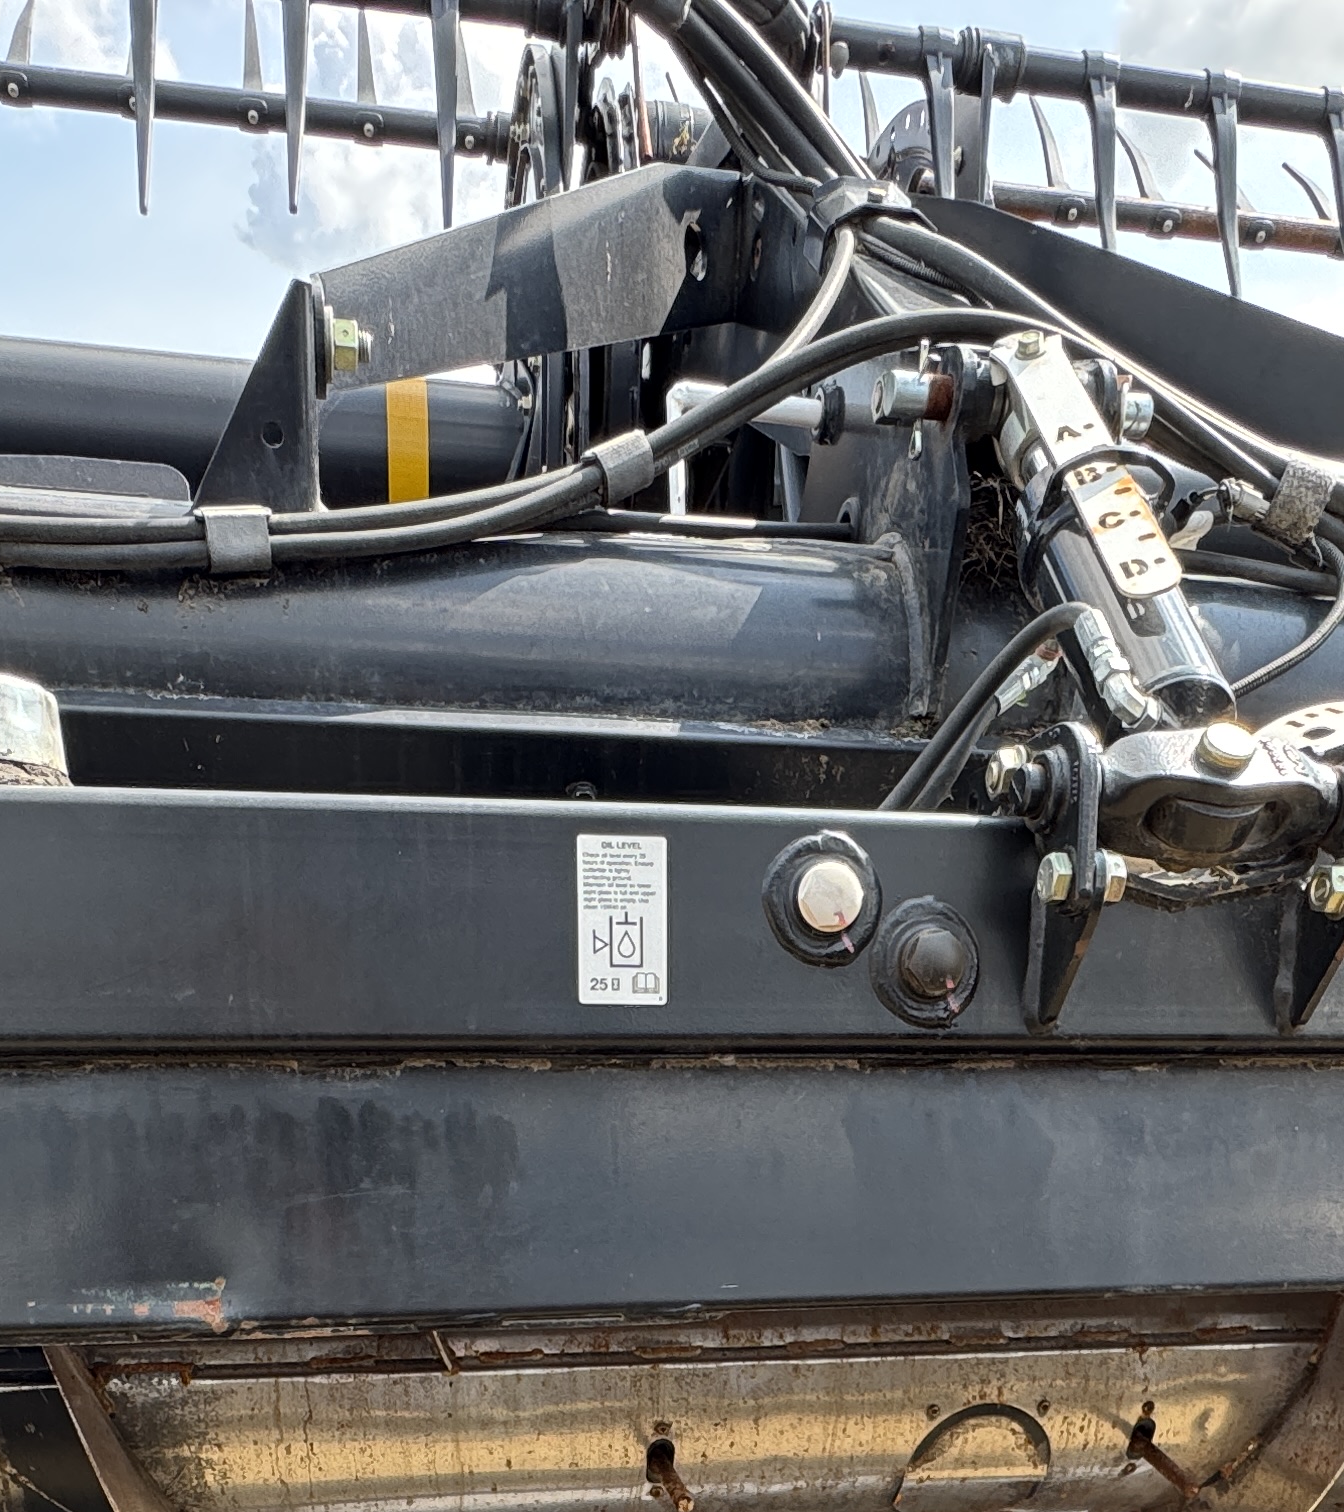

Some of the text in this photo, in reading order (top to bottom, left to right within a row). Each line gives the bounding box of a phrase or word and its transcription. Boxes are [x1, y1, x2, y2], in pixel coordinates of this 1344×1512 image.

[1098, 512, 1125, 529] C
[1119, 559, 1149, 579] D
[601, 841, 614, 849] OIL
[590, 977, 608, 991] 25
